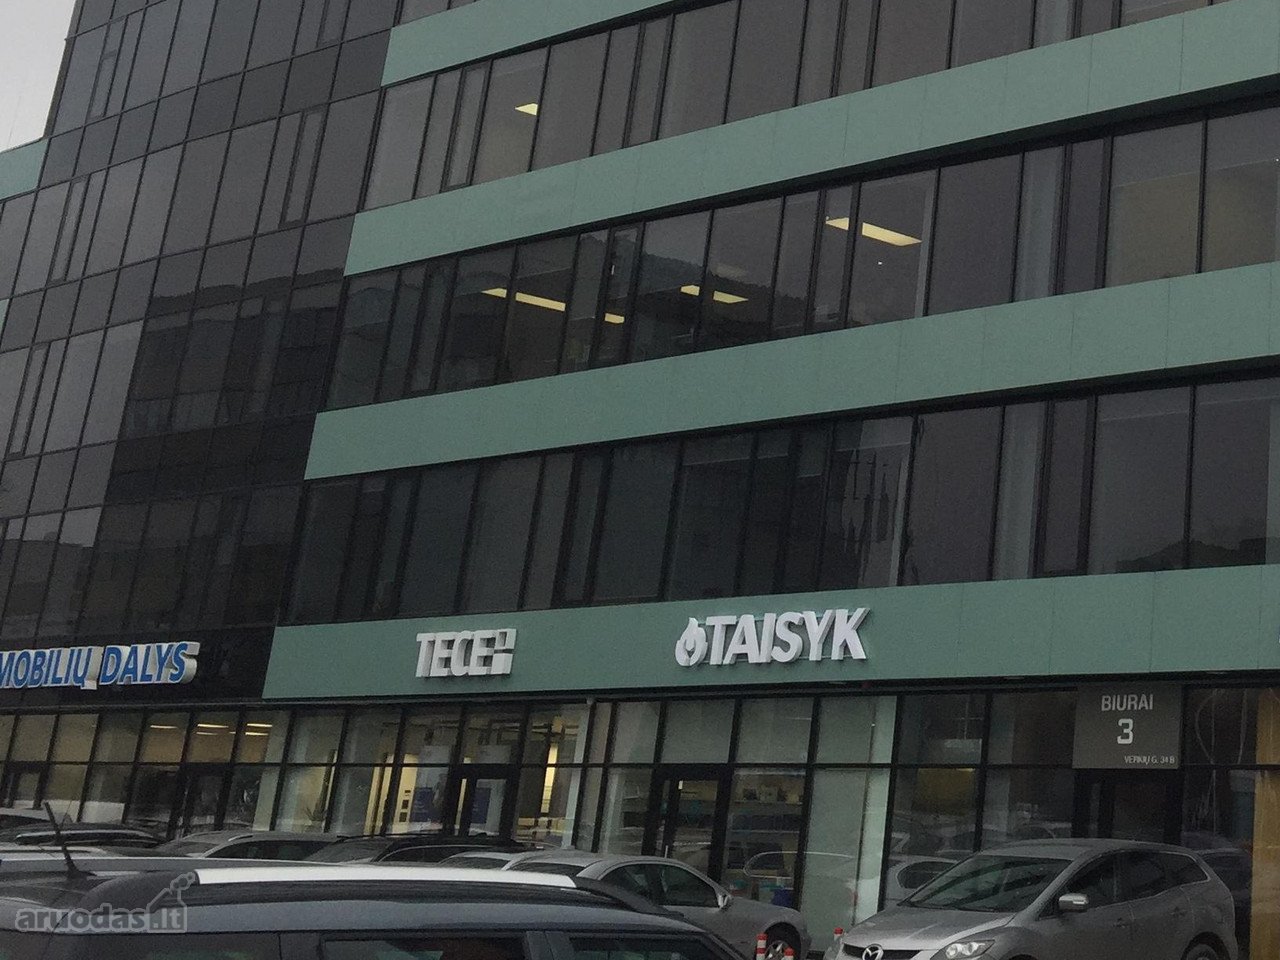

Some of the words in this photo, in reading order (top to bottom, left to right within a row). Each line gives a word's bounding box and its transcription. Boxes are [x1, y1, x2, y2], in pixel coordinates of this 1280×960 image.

[705, 606, 871, 666] TAISYK
[99, 641, 200, 686] DALYS
[1101, 693, 1154, 711] BIURAI
[1116, 718, 1134, 745] 3
